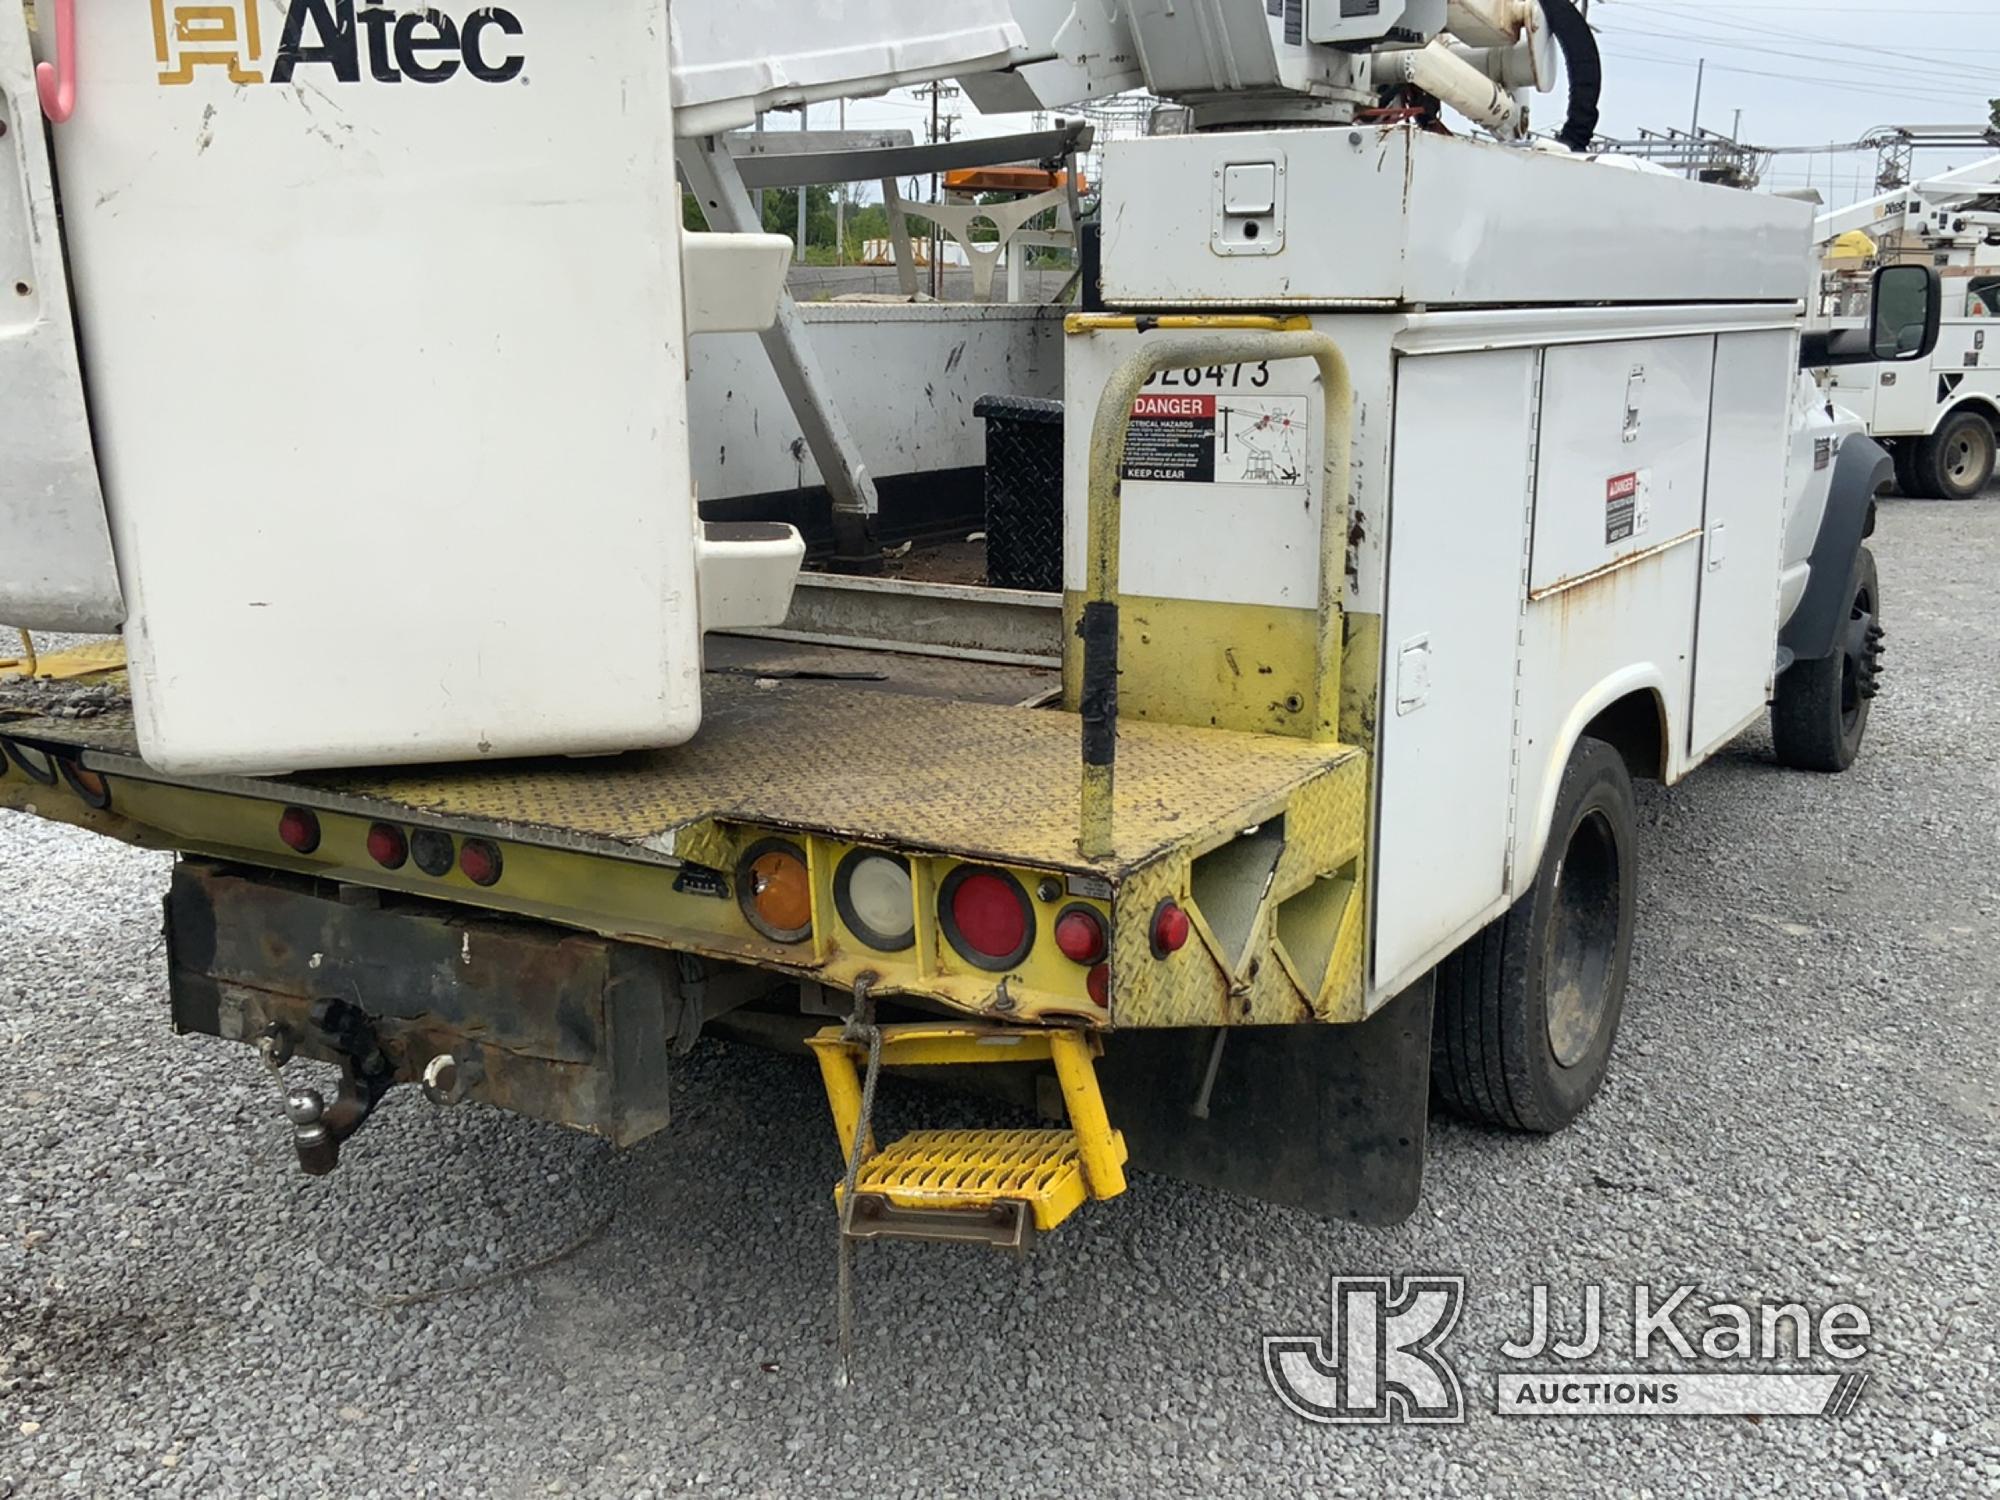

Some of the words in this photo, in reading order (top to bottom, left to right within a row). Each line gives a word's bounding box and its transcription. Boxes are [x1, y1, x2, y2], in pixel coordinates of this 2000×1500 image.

[270, 0, 525, 84] Altec
[1135, 398, 1203, 414] DANGER
[1127, 469, 1152, 477] KEEP
[1154, 470, 1185, 478] CLEAR
